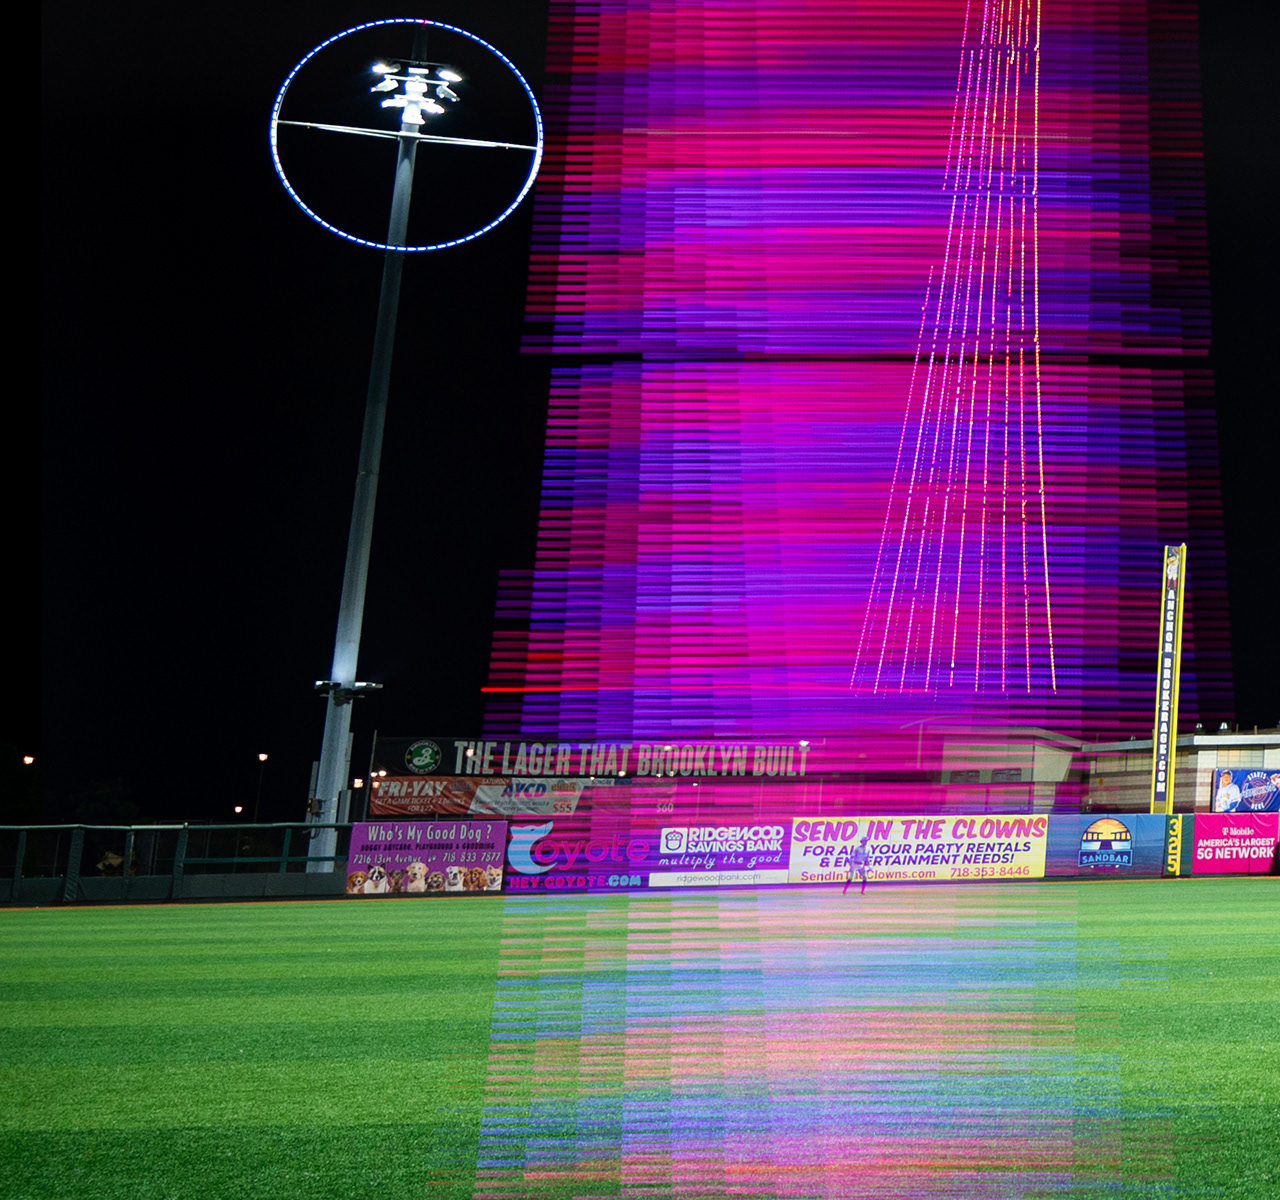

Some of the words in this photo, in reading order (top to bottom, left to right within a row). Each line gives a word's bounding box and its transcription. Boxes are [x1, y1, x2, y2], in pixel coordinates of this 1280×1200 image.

[1165, 590, 1175, 653] ANCHOR
[1156, 658, 1172, 793] BROKERAGE.COM
[454, 741, 497, 775] THE
[502, 742, 572, 776] LAGER
[578, 743, 632, 776] THAT
[637, 744, 747, 777] BROOKLYN
[753, 746, 810, 777] BUILT
[1247, 771, 1267, 781] STARTS
[378, 780, 447, 797] FRI-YAY
[553, 803, 572, 813] $55
[656, 803, 674, 813] $60
[1251, 802, 1265, 810] HERE
[368, 825, 402, 841] Who's
[407, 825, 422, 843] My
[427, 825, 455, 840] Good
[460, 825, 482, 842] Dog
[687, 826, 785, 841] RIDGEWOOD
[793, 820, 859, 842] SEND
[867, 820, 896, 841] IN
[901, 819, 946, 840] THE
[951, 817, 1047, 840] CLOWNS
[461, 842, 495, 850] GROOMING
[687, 840, 743, 853] SAVINGS
[746, 838, 783, 851] BANK
[803, 845, 836, 856] FOR
[837, 845, 858, 856] AL
[870, 843, 912, 855] YOUR
[914, 842, 964, 855] PARTY
[966, 841, 1031, 853] RENTALS
[1198, 838, 1240, 847] AMERICA'S
[1241, 838, 1275, 846] LARGEST
[353, 854, 371, 864] 7216
[442, 852, 456, 862] 718
[460, 852, 476, 862] 833
[481, 851, 501, 862] 7877
[659, 851, 716, 870] multiply
[723, 850, 744, 864] the
[747, 851, 781, 868] good
[1082, 854, 1129, 864] SANDBAR
[1196, 847, 1213, 860] 5G
[1215, 846, 1275, 860] NETWORK
[819, 857, 830, 868] &
[834, 854, 961, 867] ENERTAINMENT
[962, 853, 1014, 865] NEEDS!
[676, 872, 761, 883] ridgewoodbank.com
[950, 866, 1030, 878] 718-353-8446
[510, 875, 642, 889] HEY-COYOTE.COM
